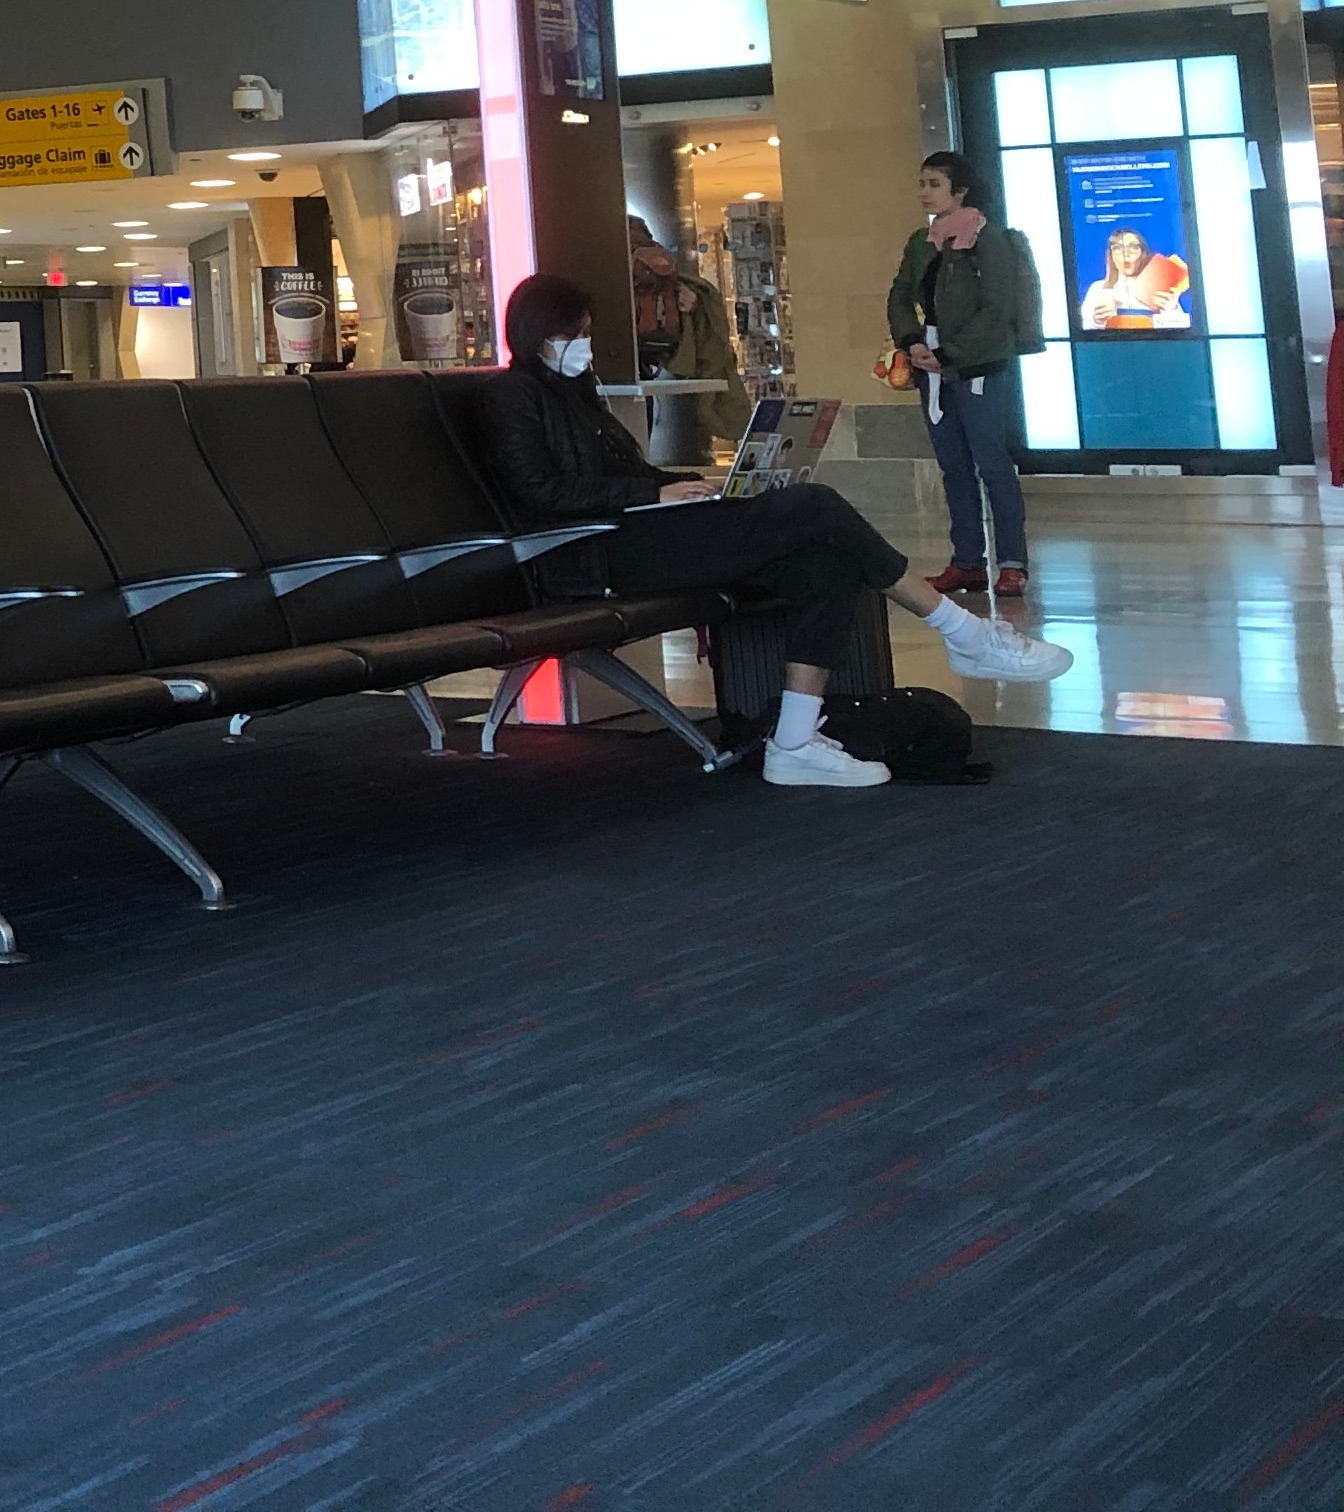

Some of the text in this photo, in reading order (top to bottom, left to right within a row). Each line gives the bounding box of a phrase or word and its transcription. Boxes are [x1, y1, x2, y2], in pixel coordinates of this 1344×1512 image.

[6, 102, 80, 122] Gates 1-16
[50, 121, 82, 129] Puertas
[46, 147, 86, 163] Claim
[37, 166, 48, 175] de
[51, 165, 88, 176] equipaje
[282, 272, 314, 280] THIS IS
[280, 280, 316, 292] COFFEE
